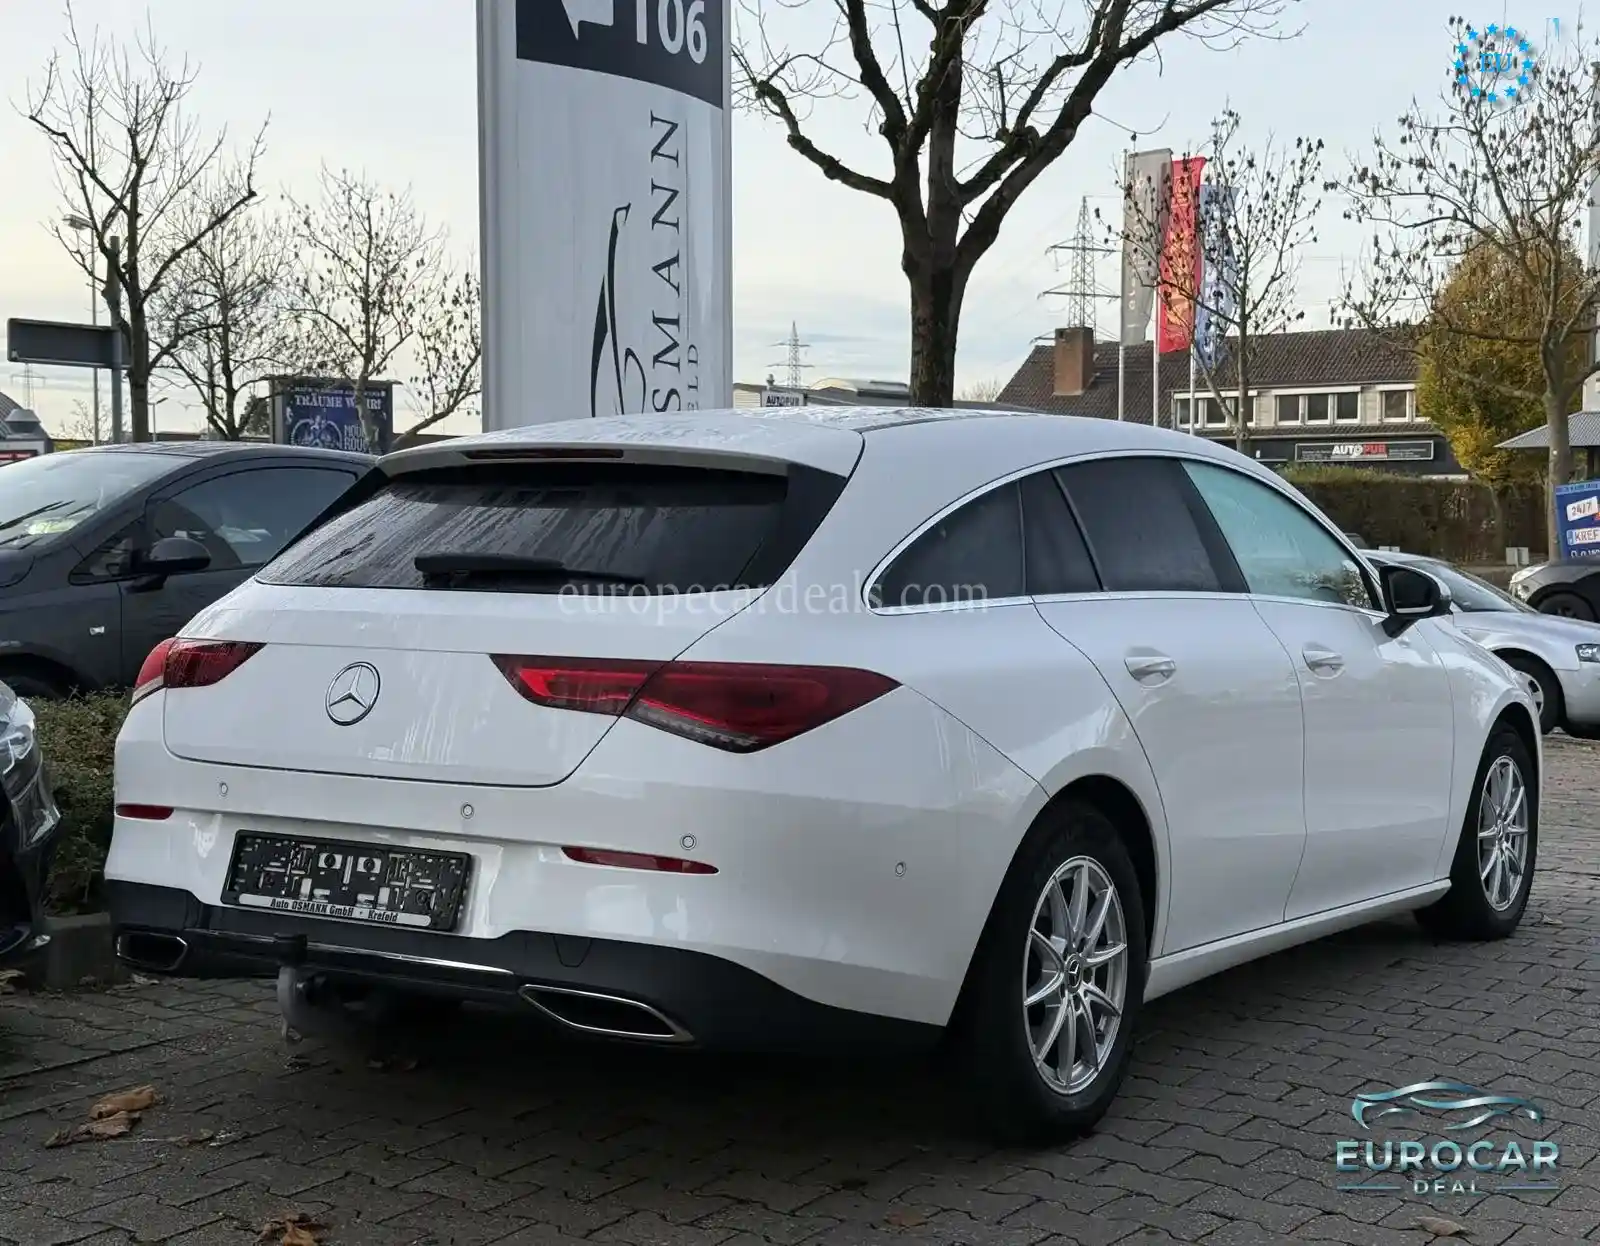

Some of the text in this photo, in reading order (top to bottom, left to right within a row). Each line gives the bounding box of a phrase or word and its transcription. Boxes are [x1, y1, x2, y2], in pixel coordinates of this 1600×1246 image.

[270, 898, 399, 922] Auto OSMANN GmbH Krefeld
